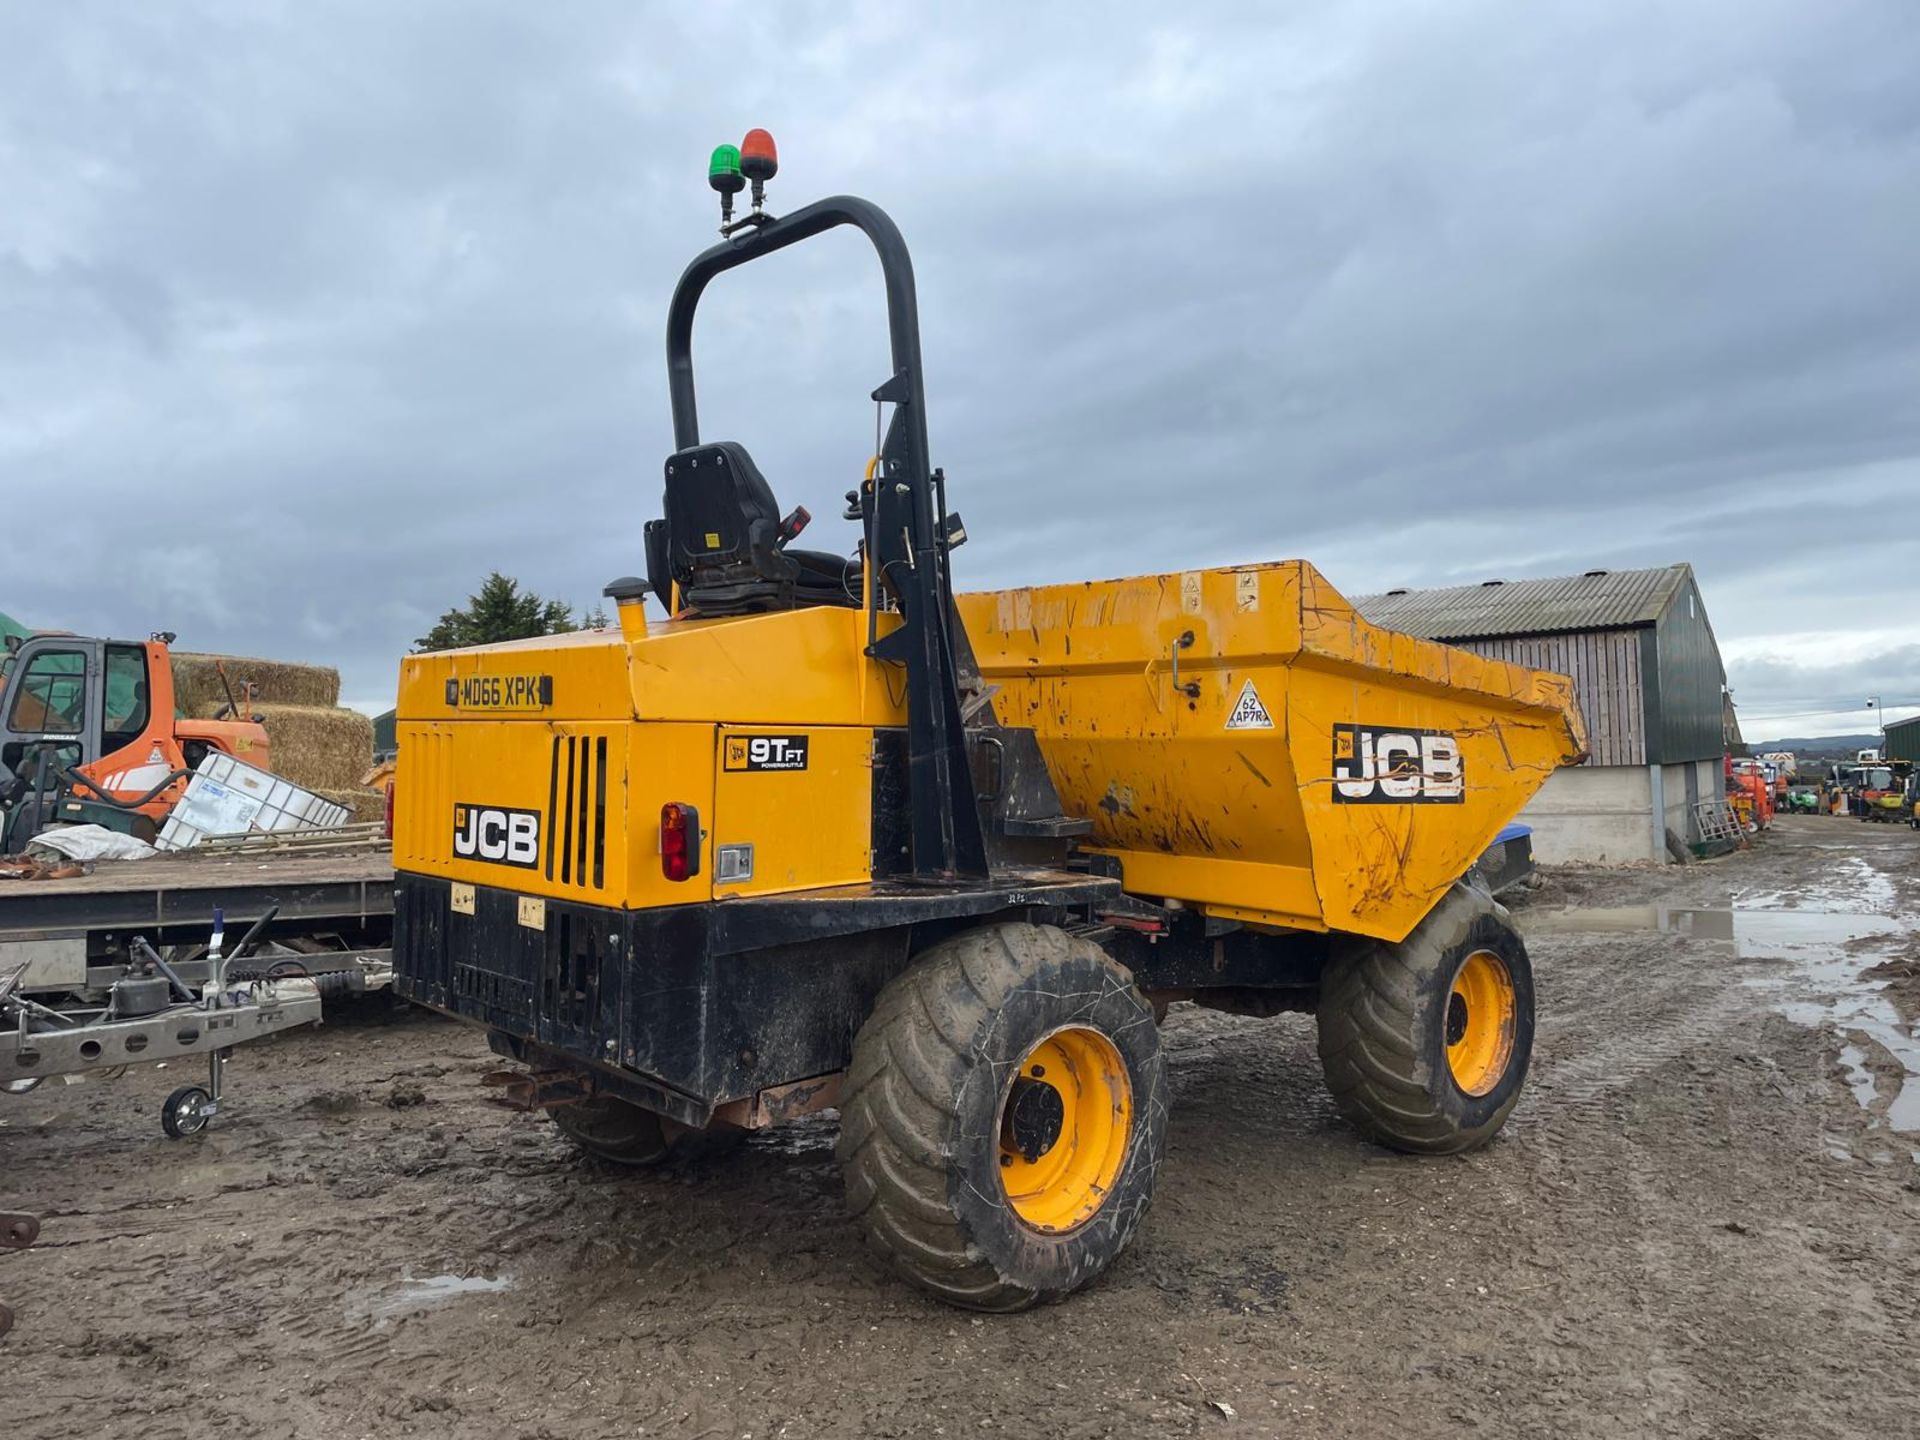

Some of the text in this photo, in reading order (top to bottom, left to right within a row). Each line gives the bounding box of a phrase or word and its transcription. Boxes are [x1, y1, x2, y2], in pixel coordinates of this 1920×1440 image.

[464, 676, 536, 706] MD66 XPK
[1242, 698, 1256, 710] 62
[1236, 710, 1262, 722] AP7R
[1336, 732, 1460, 798] JCB
[455, 809, 538, 864] JCB
